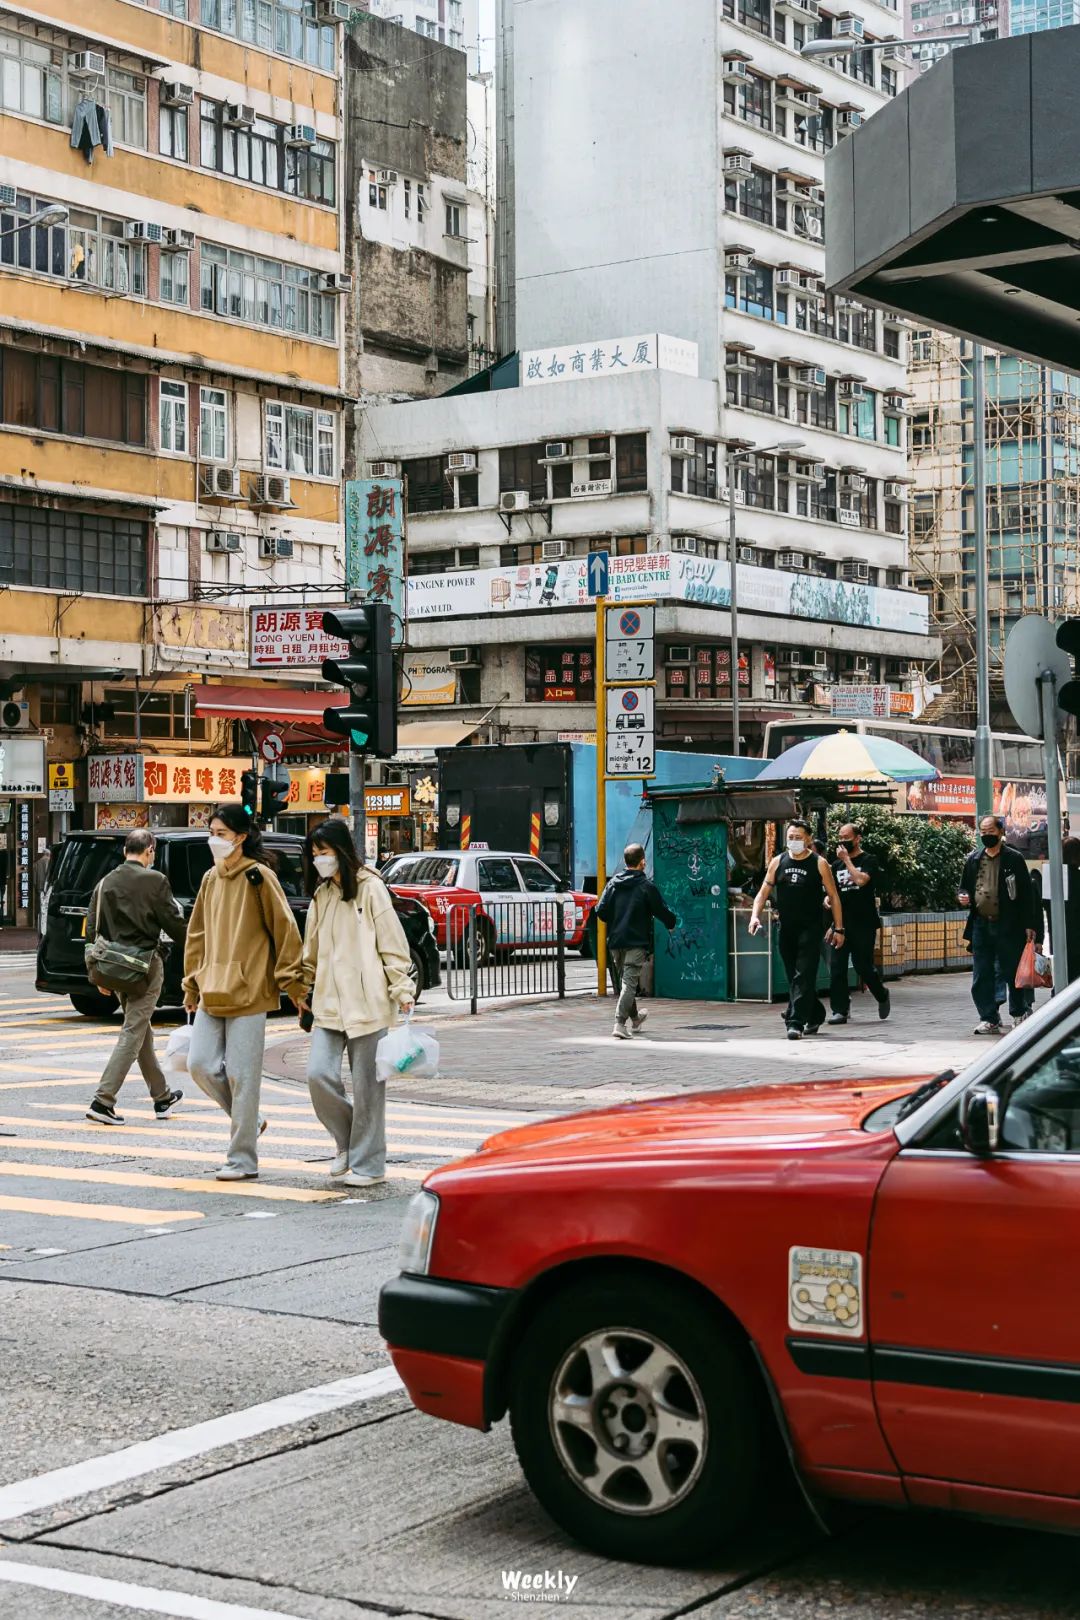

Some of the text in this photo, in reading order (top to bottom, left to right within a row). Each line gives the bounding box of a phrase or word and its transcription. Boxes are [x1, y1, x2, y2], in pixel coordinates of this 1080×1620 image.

[415, 579, 445, 590] ENGINE
[447, 577, 475, 588] POWER
[616, 573, 638, 585] BABY
[638, 570, 670, 583] CENTRE
[255, 634, 282, 643] LONG
[288, 633, 315, 642] YUEN
[254, 644, 275, 655] 時租
[282, 644, 302, 654] 日租
[636, 642, 645, 655] 7
[636, 663, 645, 676] 7
[546, 688, 563, 698] 入口
[636, 735, 645, 748] 7
[636, 756, 651, 769] 12
[89, 757, 137, 789] 朗源賓館
[63, 802, 73, 810] 12
